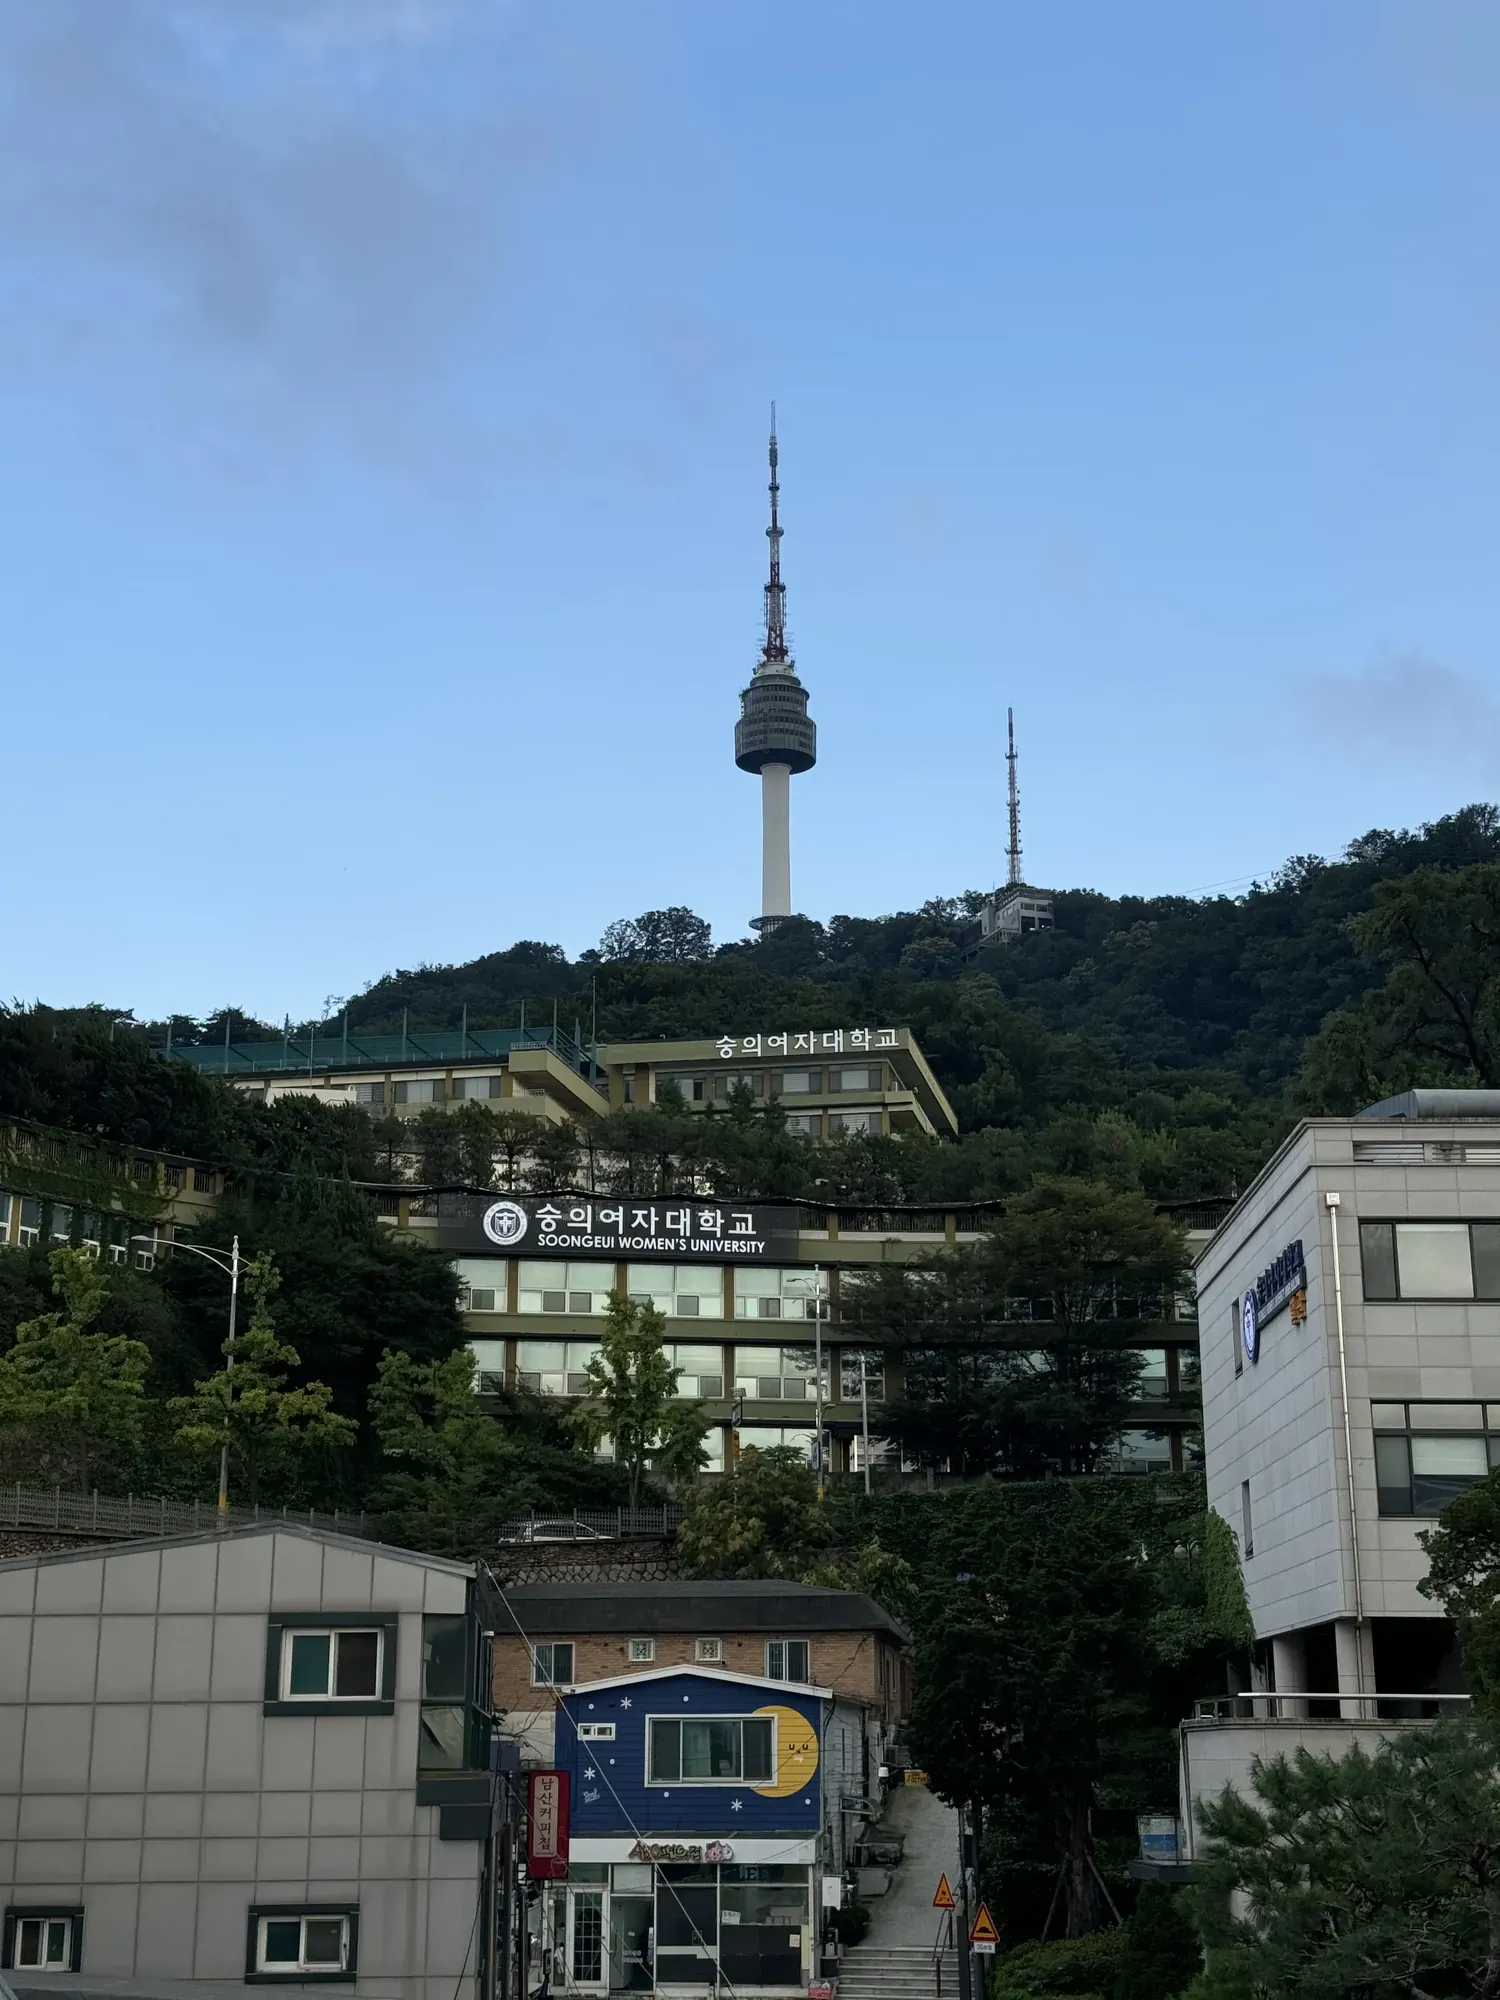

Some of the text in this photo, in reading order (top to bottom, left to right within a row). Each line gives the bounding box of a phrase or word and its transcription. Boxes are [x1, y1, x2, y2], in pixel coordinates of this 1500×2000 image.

[715, 1027, 900, 1059] 숭의여자대학교
[535, 1203, 757, 1238] 숭의여자대학교
[537, 1233, 766, 1254] SOONGEUI WOMEN'S UNIVERSITY
[539, 1777, 554, 1851] 남산커피집
